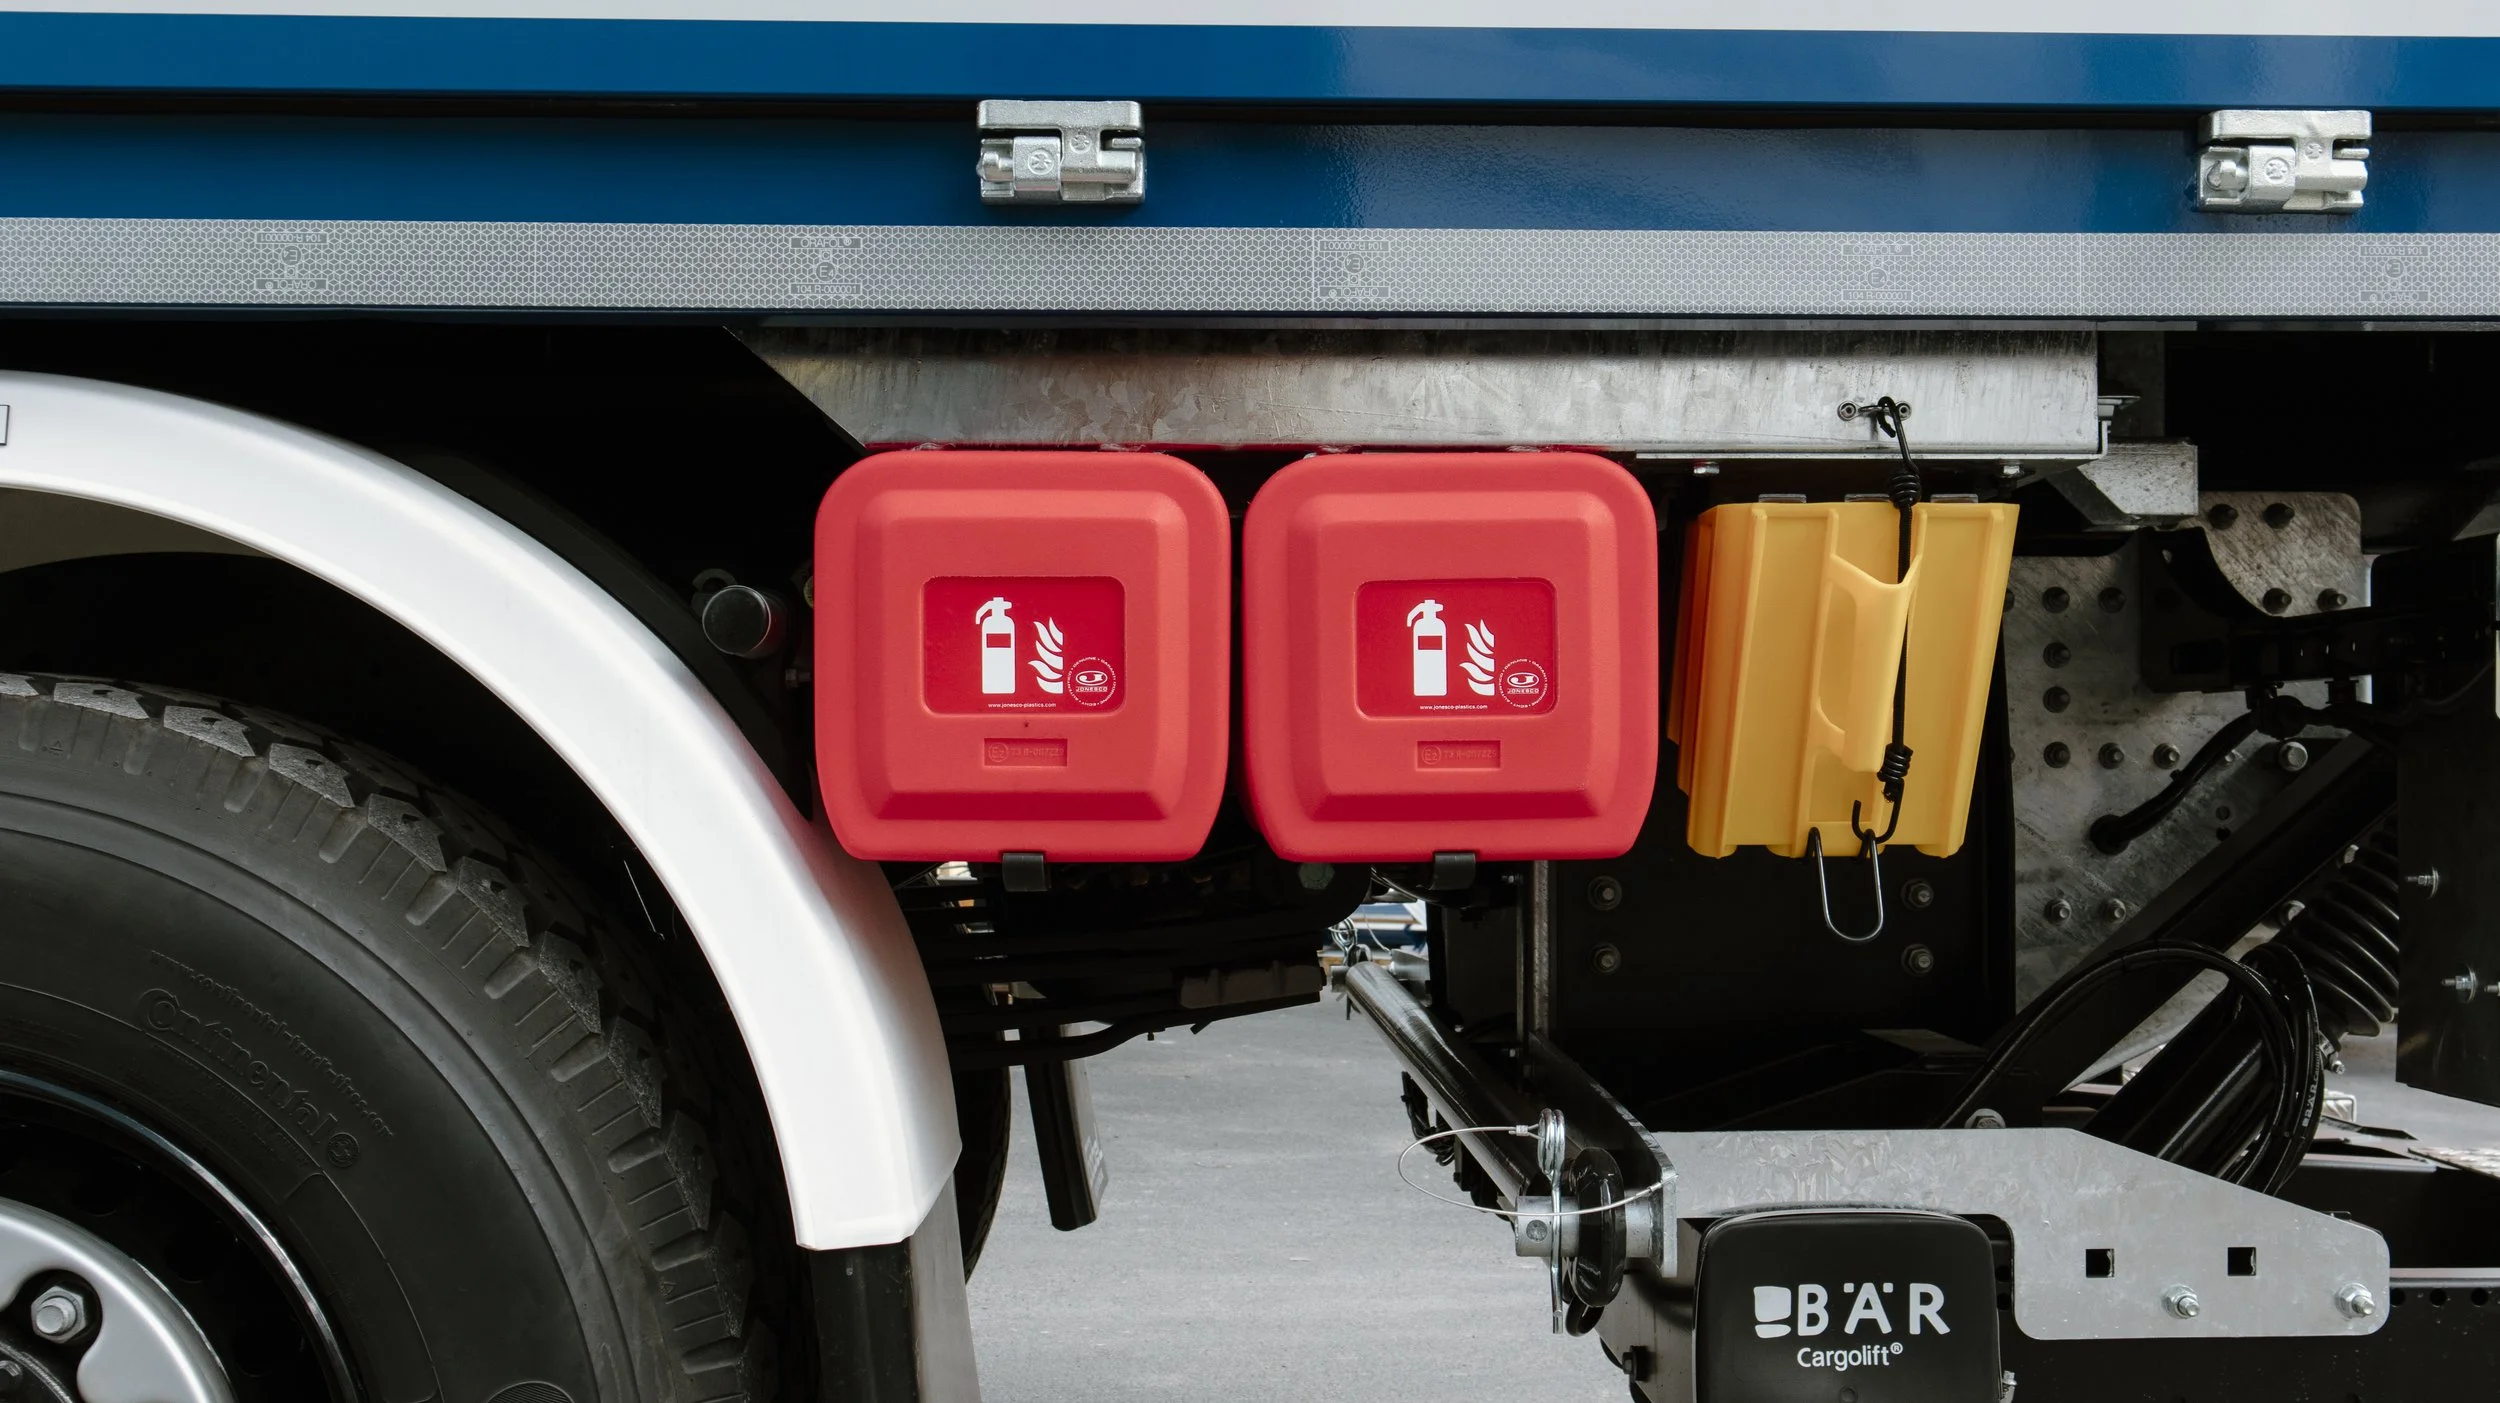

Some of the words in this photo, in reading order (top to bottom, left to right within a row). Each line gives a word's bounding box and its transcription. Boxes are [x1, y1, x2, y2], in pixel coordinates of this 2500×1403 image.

[306, 234, 320, 242] 104
[1368, 242, 1383, 250] 104
[796, 285, 812, 294] 104
[135, 986, 338, 1145] Continental
[1797, 1282, 1951, 1336] BÄR
[1797, 1342, 1904, 1372] Cargolift®
